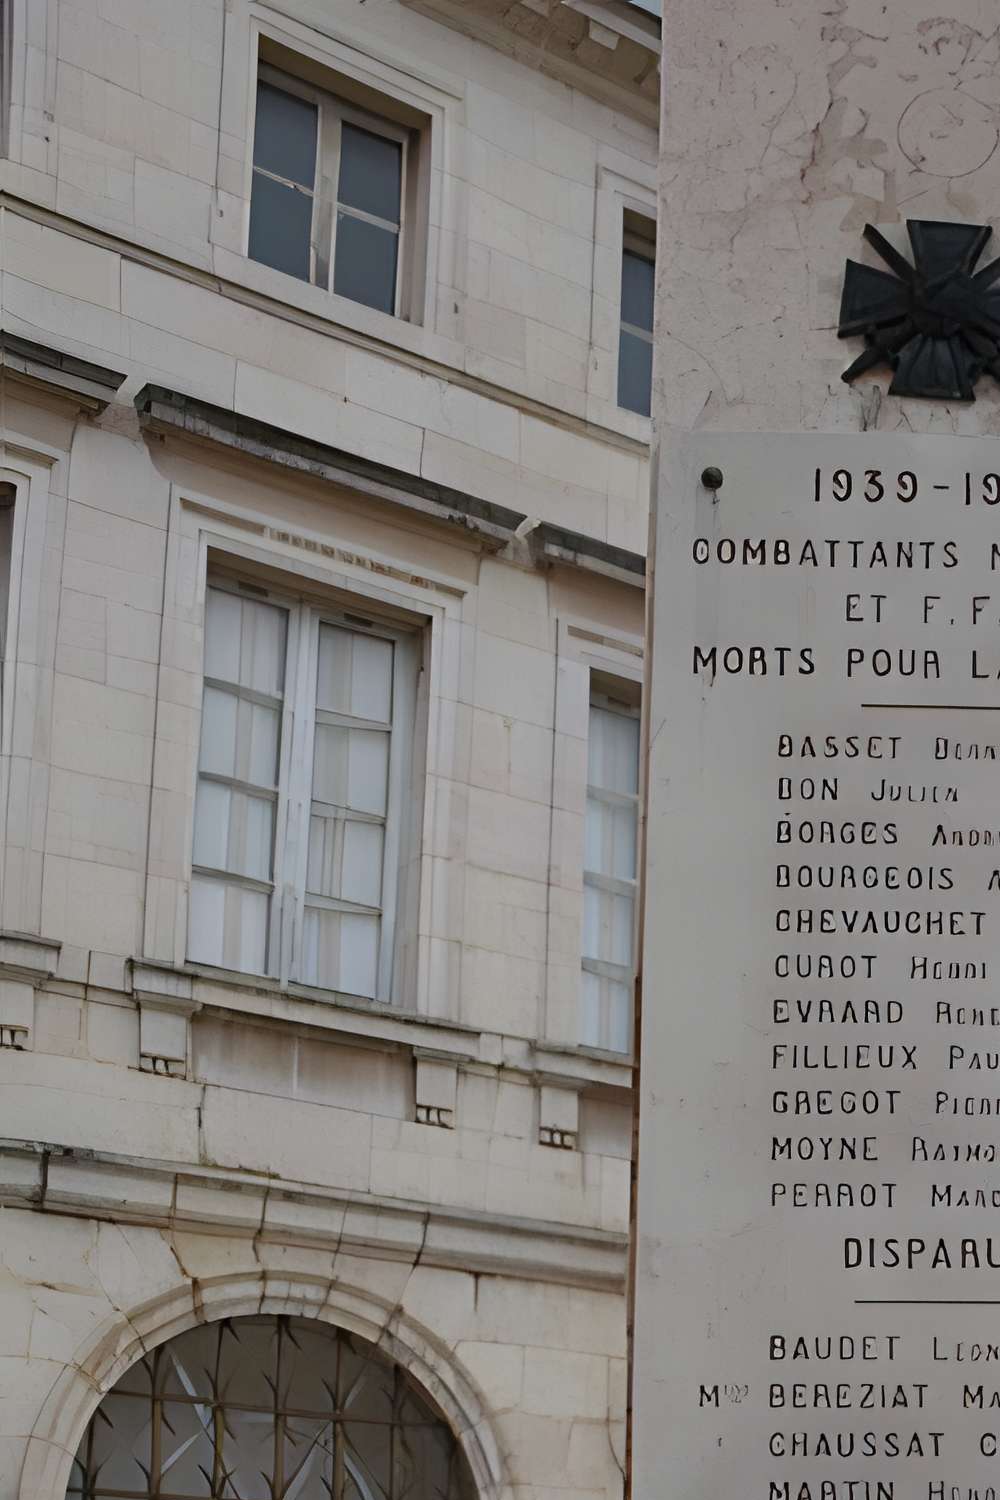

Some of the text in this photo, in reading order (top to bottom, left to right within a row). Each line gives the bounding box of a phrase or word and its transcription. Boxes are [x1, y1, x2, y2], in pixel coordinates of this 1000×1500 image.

[693, 538, 958, 569] COMBATTANTS
[846, 594, 887, 623] ET
[693, 646, 814, 677] MORTS
[847, 648, 940, 679] POUR
[776, 909, 986, 935] CHEVAUCHET
[773, 1045, 916, 1070] FILLIEUX
[771, 1137, 878, 1161] MOYNE
[770, 1335, 900, 1360] BAUDET
[769, 1384, 928, 1408] BEREZIAT
[769, 1432, 944, 1457] CHAUSSAT
